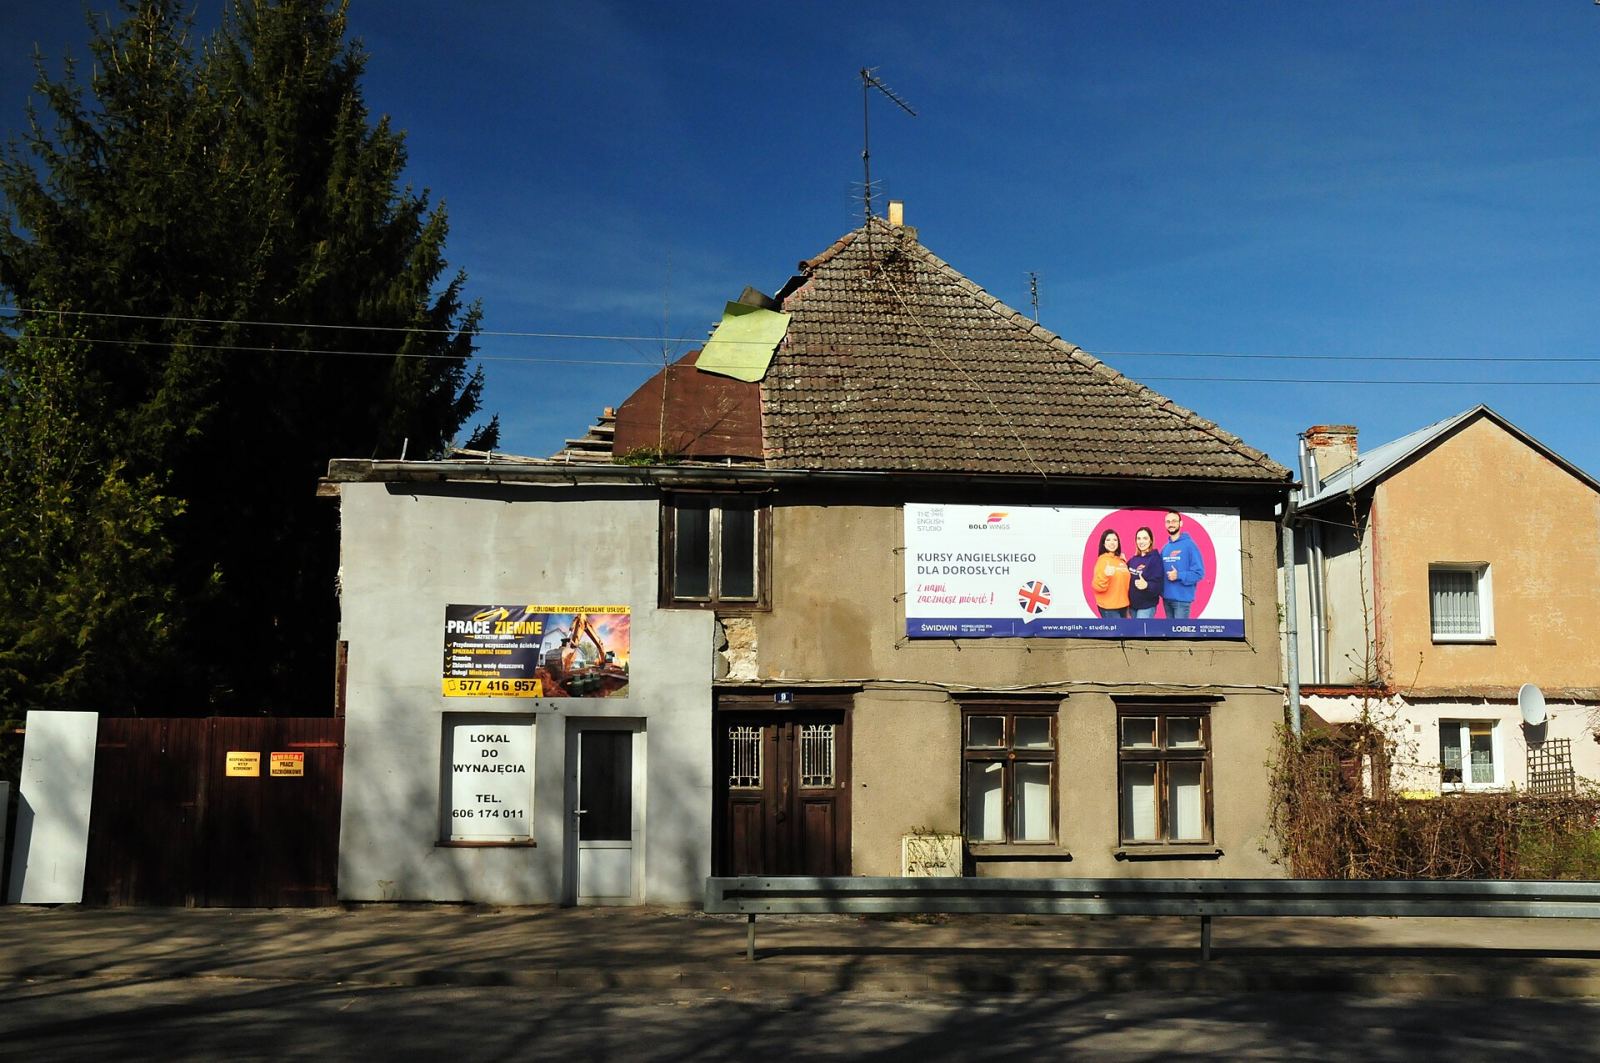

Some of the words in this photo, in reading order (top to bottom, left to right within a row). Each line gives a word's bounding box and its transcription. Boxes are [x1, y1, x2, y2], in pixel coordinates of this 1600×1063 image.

[917, 553, 953, 562] KURSY
[956, 553, 1036, 562] ANGIELSKIEGO
[917, 566, 940, 575] DLA
[942, 566, 1010, 576] DOROSŁYCH
[924, 582, 946, 593] nami
[917, 592, 956, 605] zaczniesz
[958, 592, 988, 605] mówić
[448, 620, 490, 634] PRACE
[494, 621, 542, 634] ZIEMNE
[921, 623, 958, 632] ŚWIDWIN
[1172, 625, 1196, 633] ŁOBEZ
[460, 680, 481, 691] 577
[487, 681, 509, 691] 416
[514, 681, 536, 692] 957
[470, 734, 510, 743] LOKAL
[482, 750, 498, 758] DO
[453, 764, 526, 775] WYNAJĘCIA
[476, 794, 502, 803] TEL.
[452, 809, 474, 818] 606
[478, 809, 499, 818] 174
[503, 809, 523, 818] 011
